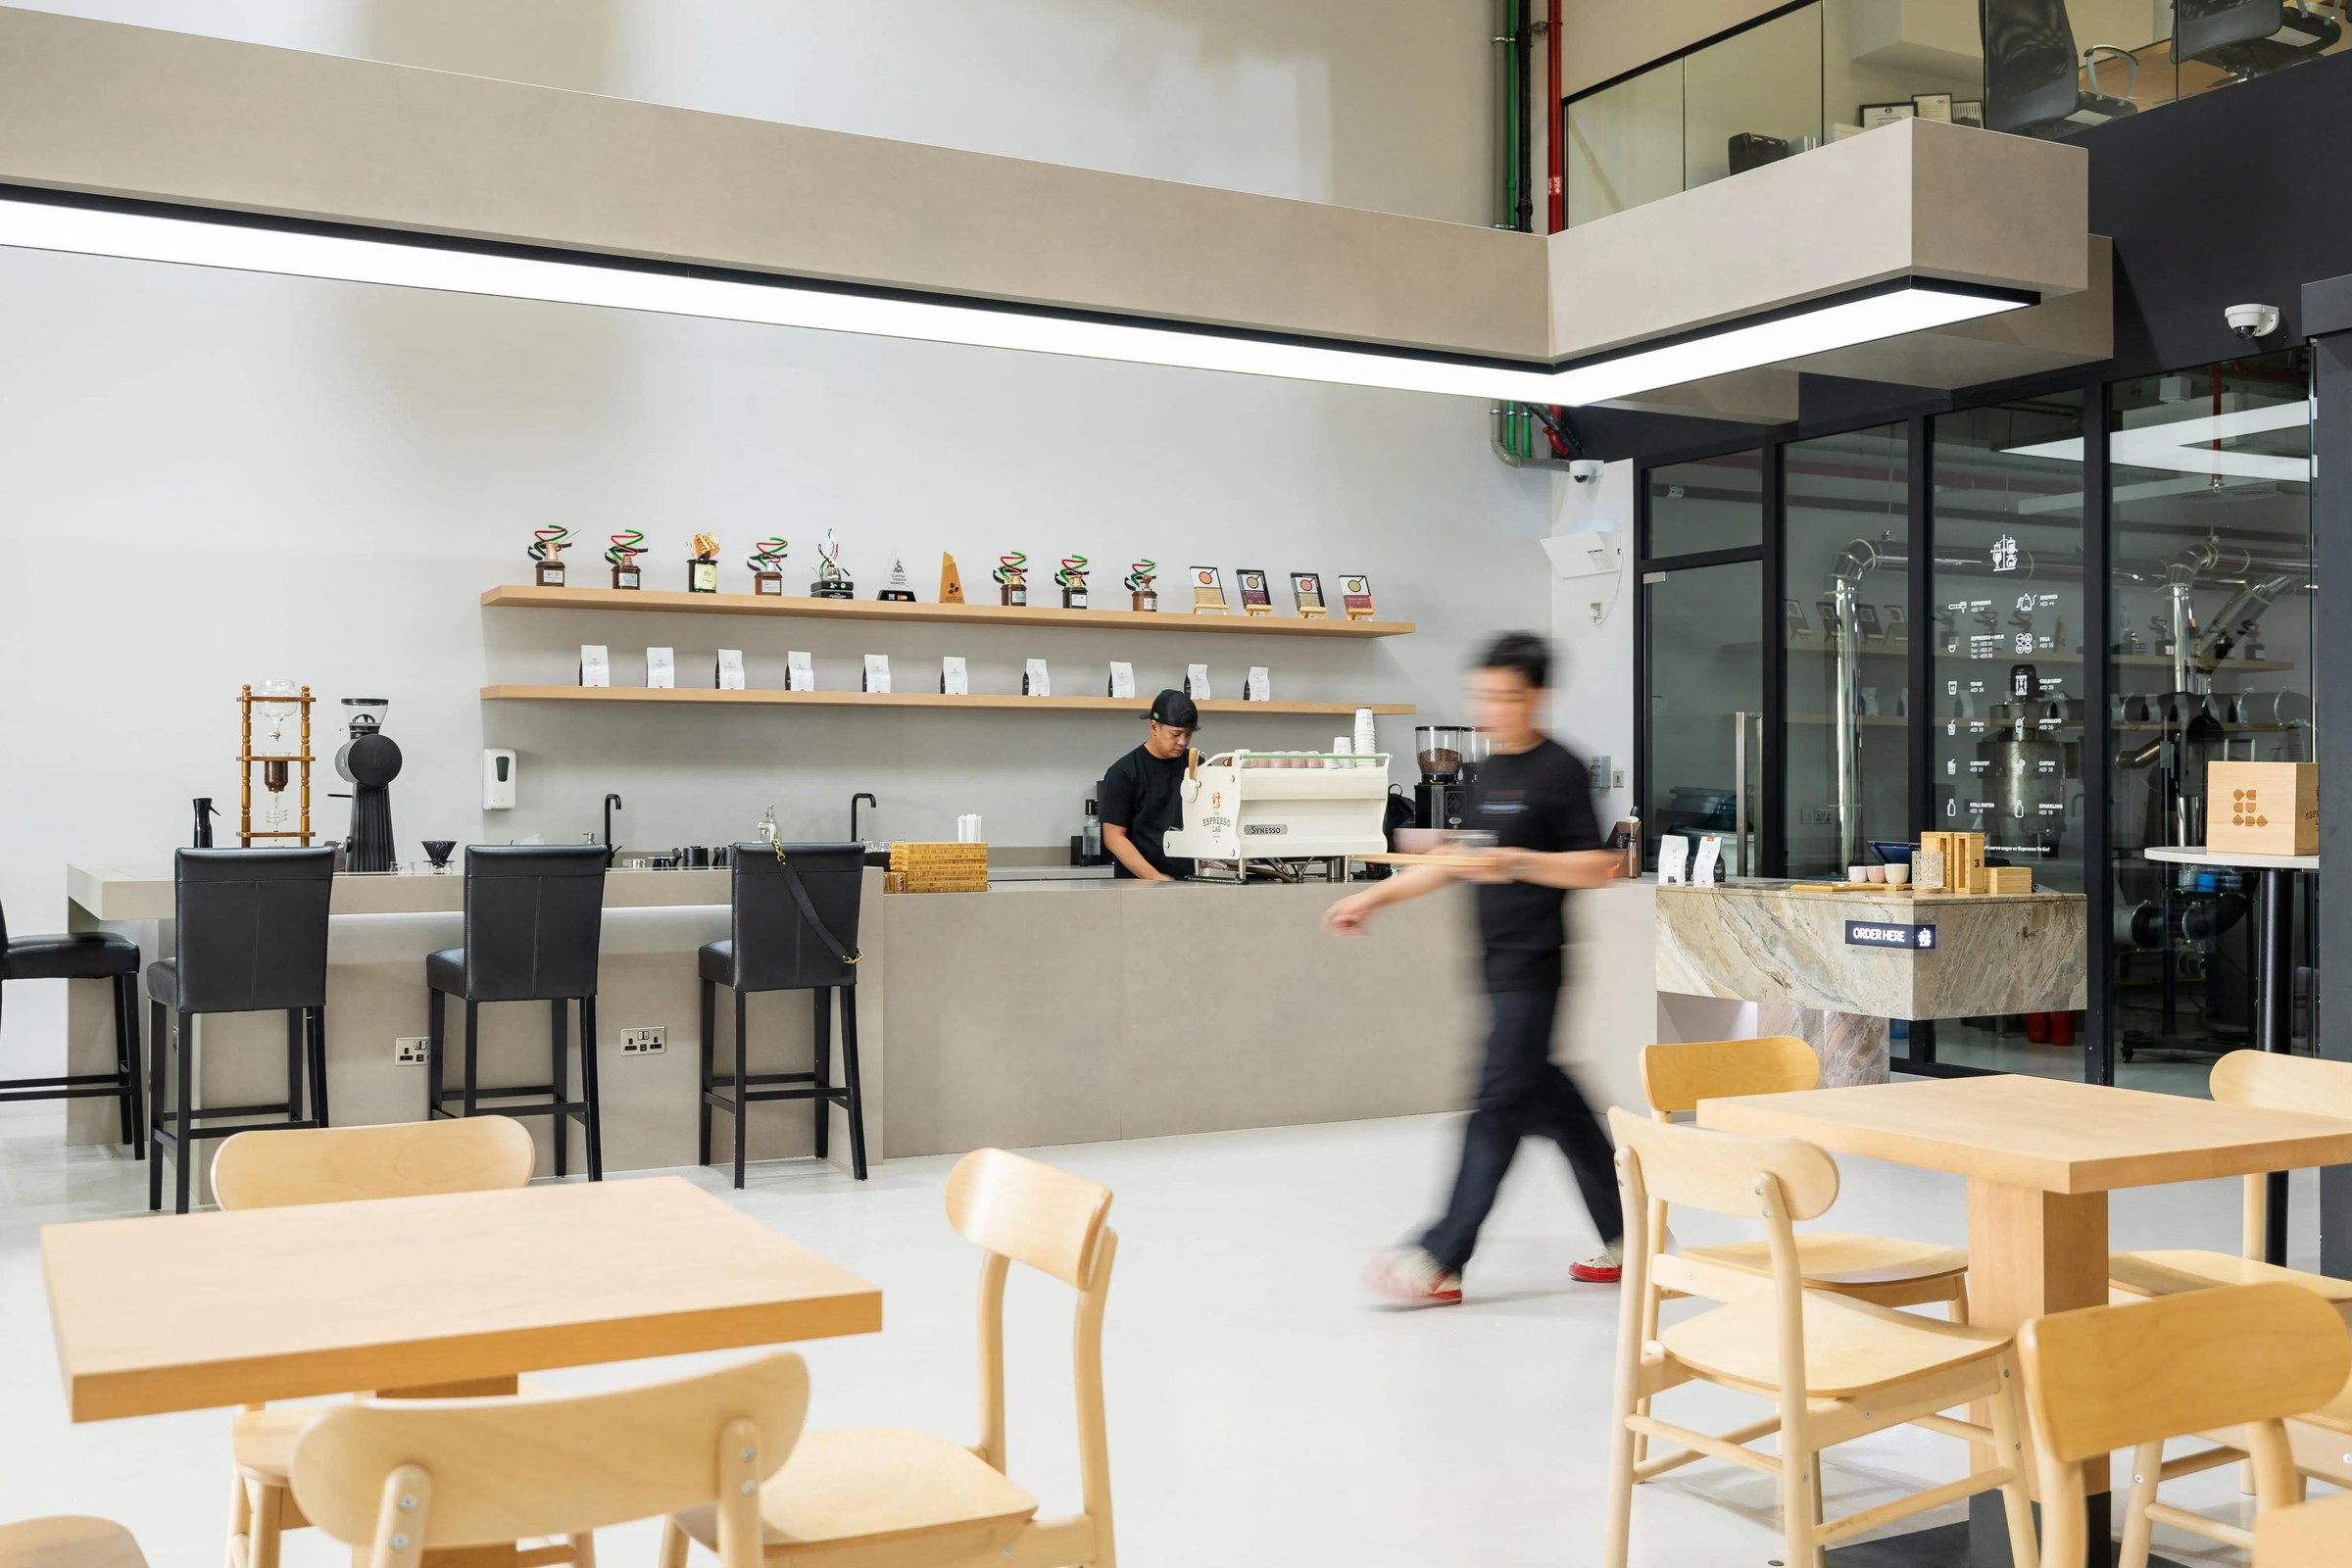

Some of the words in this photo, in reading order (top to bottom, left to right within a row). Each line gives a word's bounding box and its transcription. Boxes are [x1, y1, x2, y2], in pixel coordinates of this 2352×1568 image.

[1202, 816, 1231, 827] ESPRESSO
[1974, 859, 1980, 868] 3
[1853, 927, 1882, 940] ORDER
[1883, 930, 1906, 942] HERE
